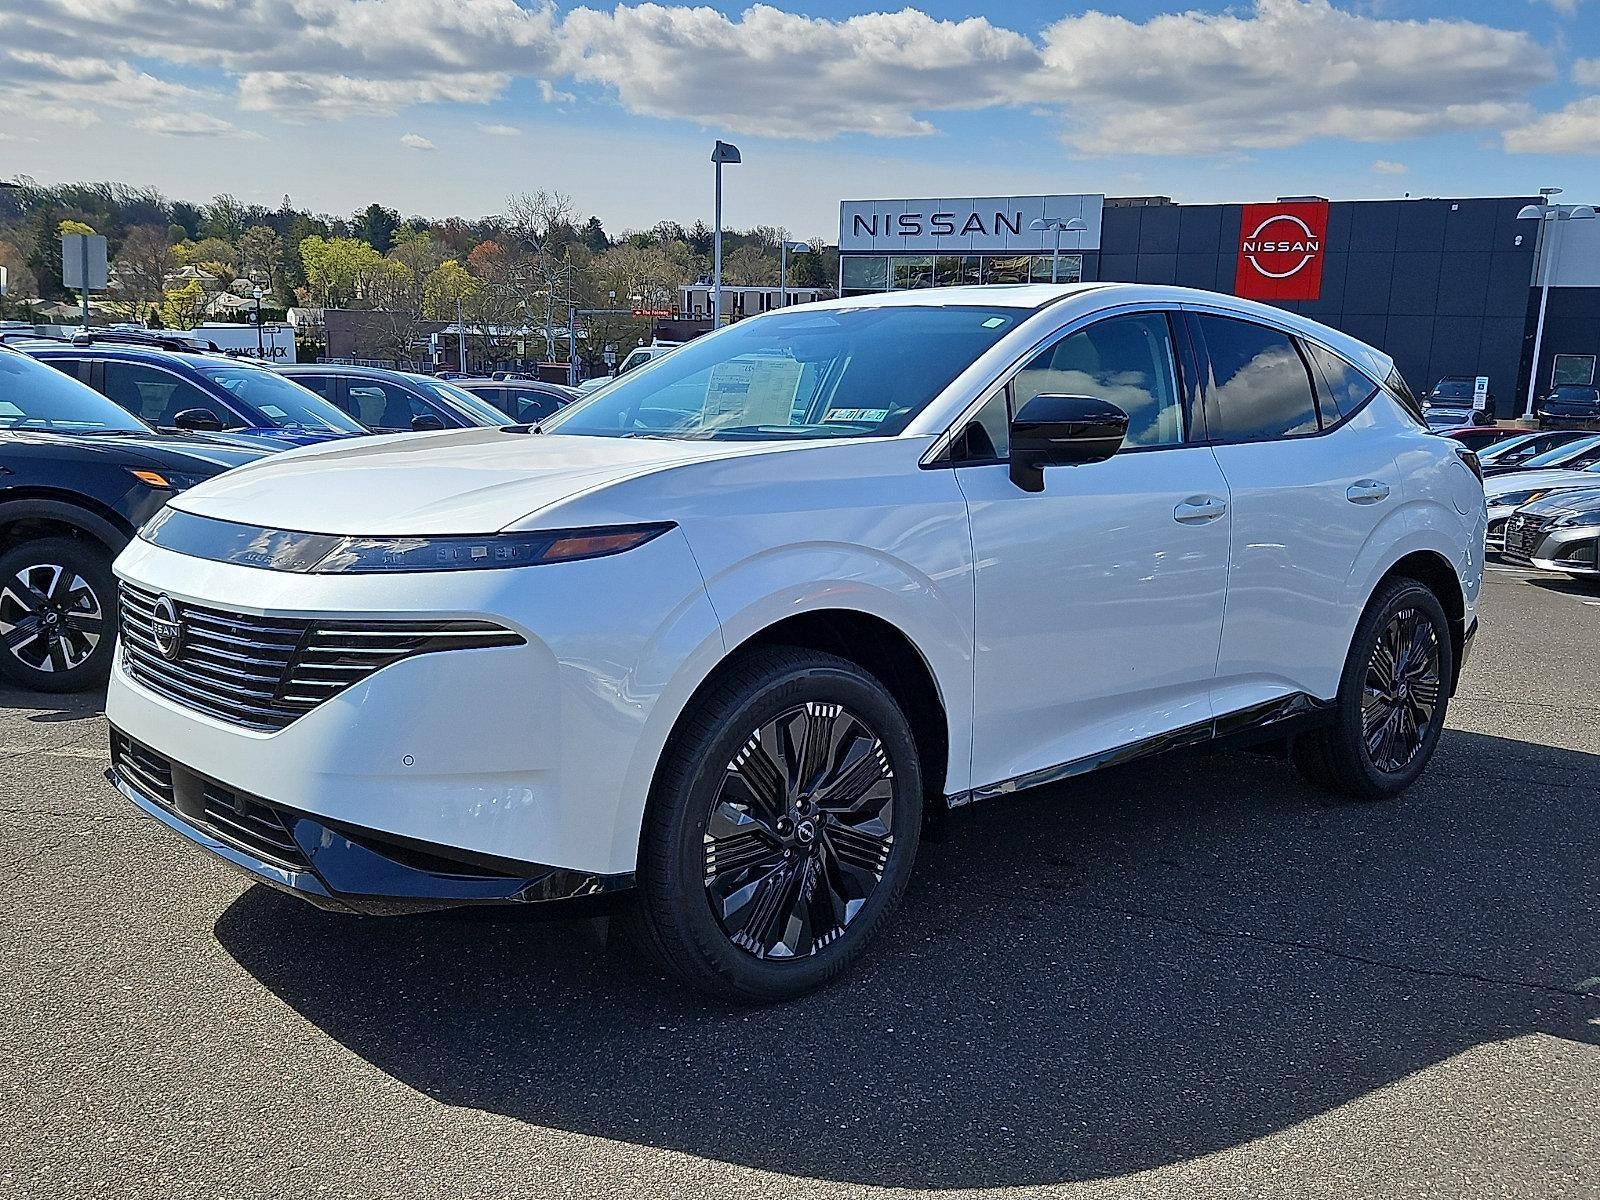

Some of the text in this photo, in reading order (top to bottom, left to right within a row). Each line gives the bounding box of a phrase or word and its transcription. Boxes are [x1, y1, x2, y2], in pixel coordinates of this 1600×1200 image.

[853, 211, 1023, 237] NISSAN
[1243, 241, 1319, 252] NISSAN
[256, 346, 288, 358] SHACK
